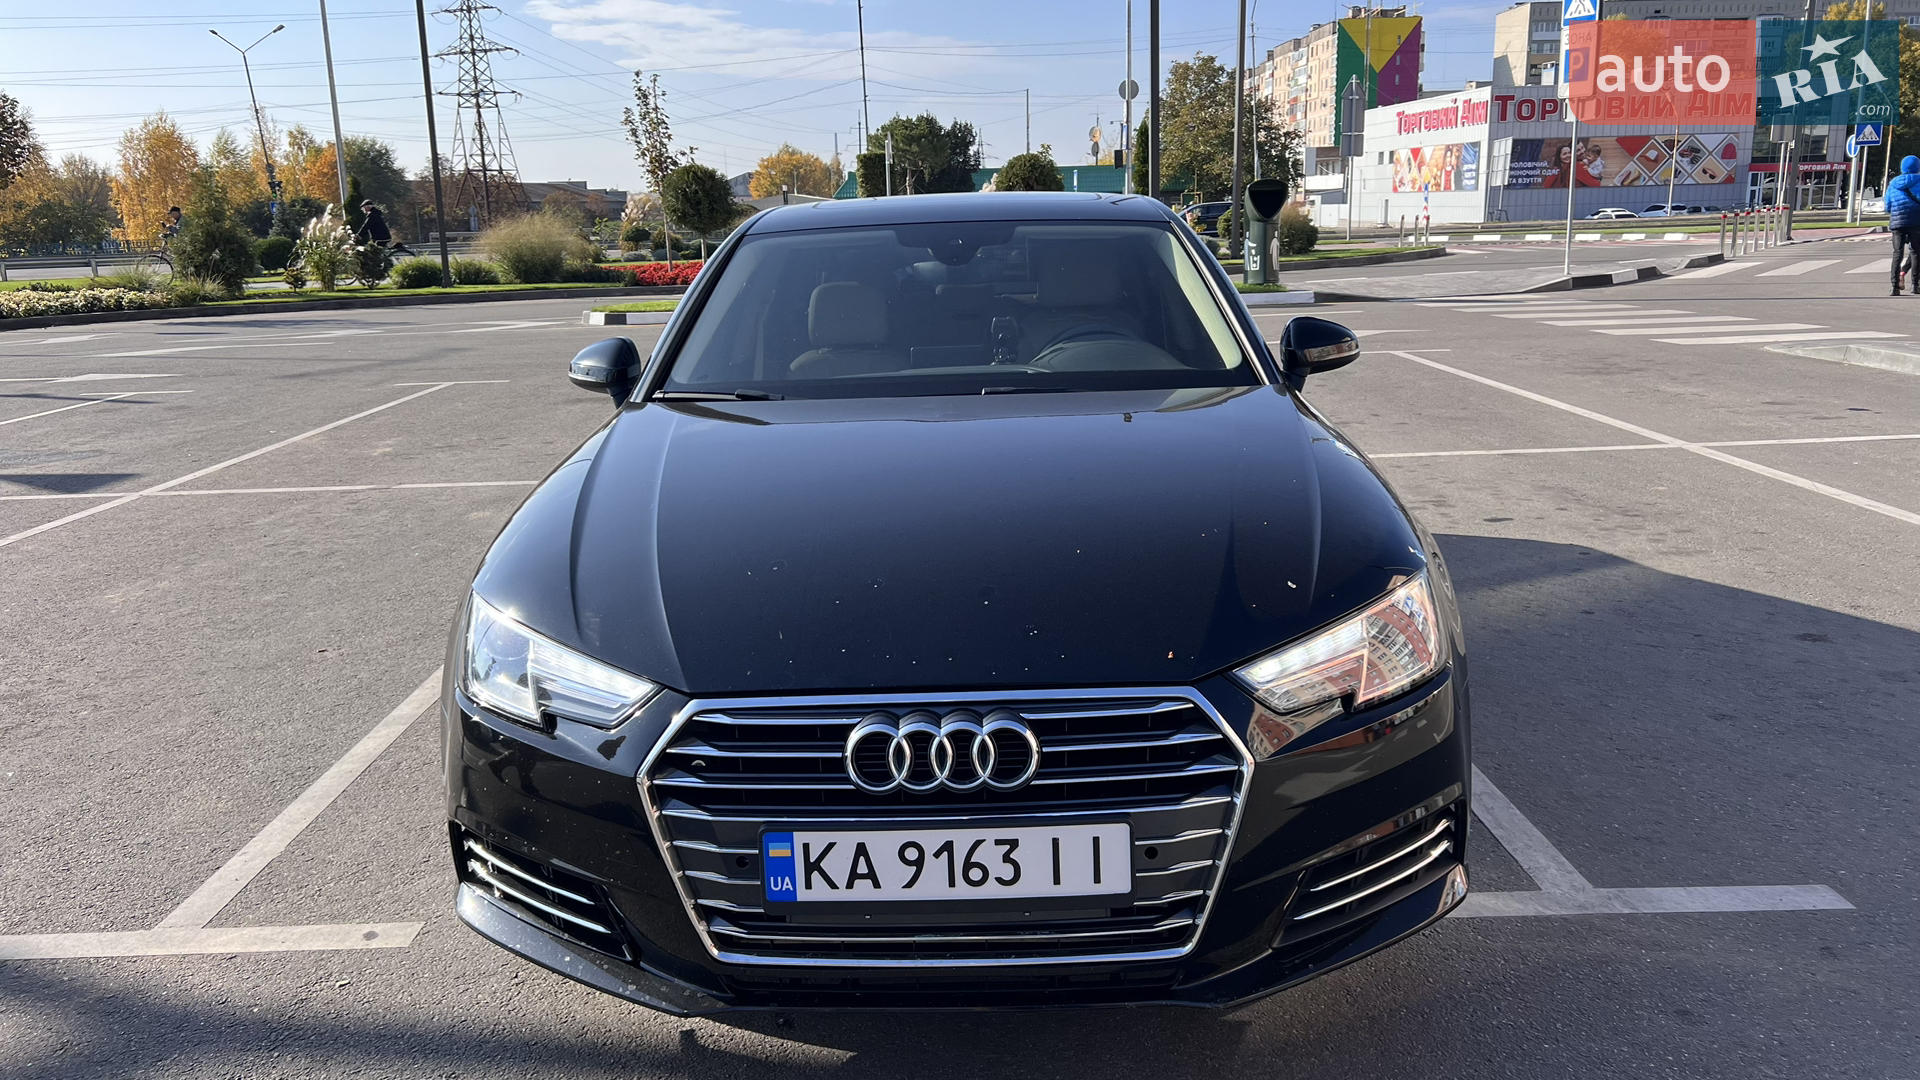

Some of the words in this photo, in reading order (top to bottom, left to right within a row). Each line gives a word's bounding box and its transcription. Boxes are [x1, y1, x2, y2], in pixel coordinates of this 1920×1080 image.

[802, 842, 882, 890] KA
[897, 838, 1022, 889] 9163
[770, 876, 793, 892] UA
